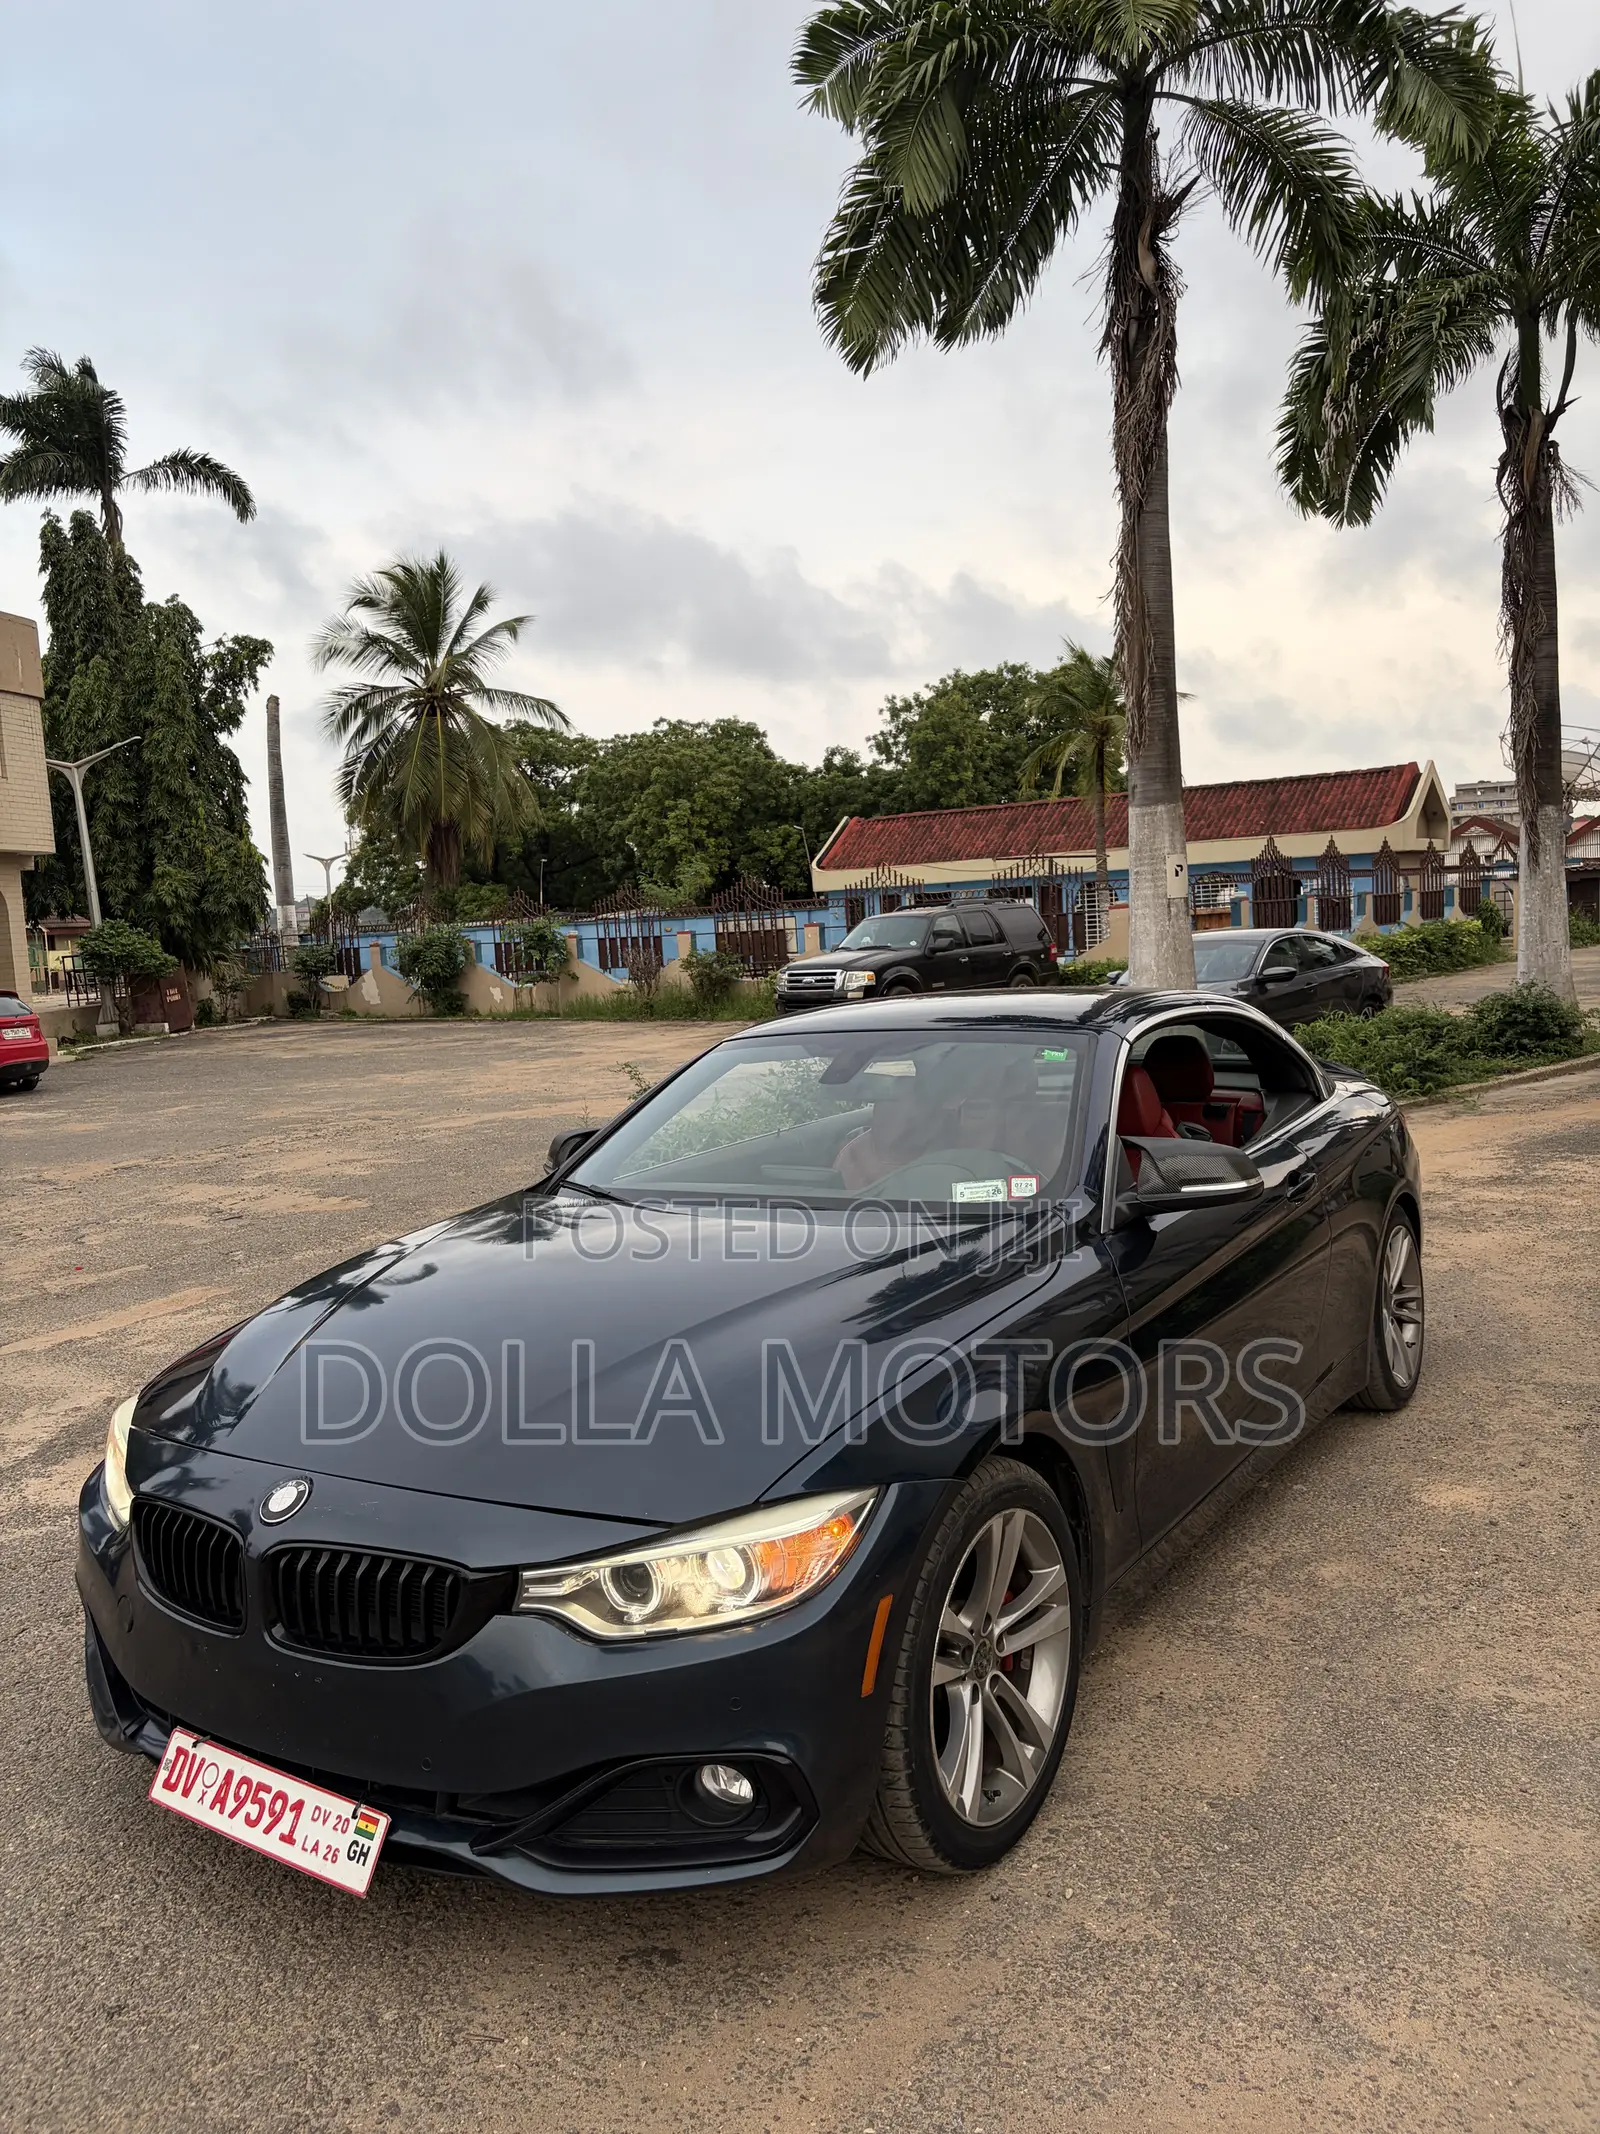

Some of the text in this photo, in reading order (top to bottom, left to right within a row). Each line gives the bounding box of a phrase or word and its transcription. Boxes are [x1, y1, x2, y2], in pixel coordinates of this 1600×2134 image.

[1174, 864, 1184, 877] P
[162, 1745, 207, 1799] DV
[209, 1768, 305, 1846] A9591
[311, 1805, 351, 1835] DV 20
[301, 1834, 340, 1864] LA 26
[346, 1839, 372, 1867] GH
